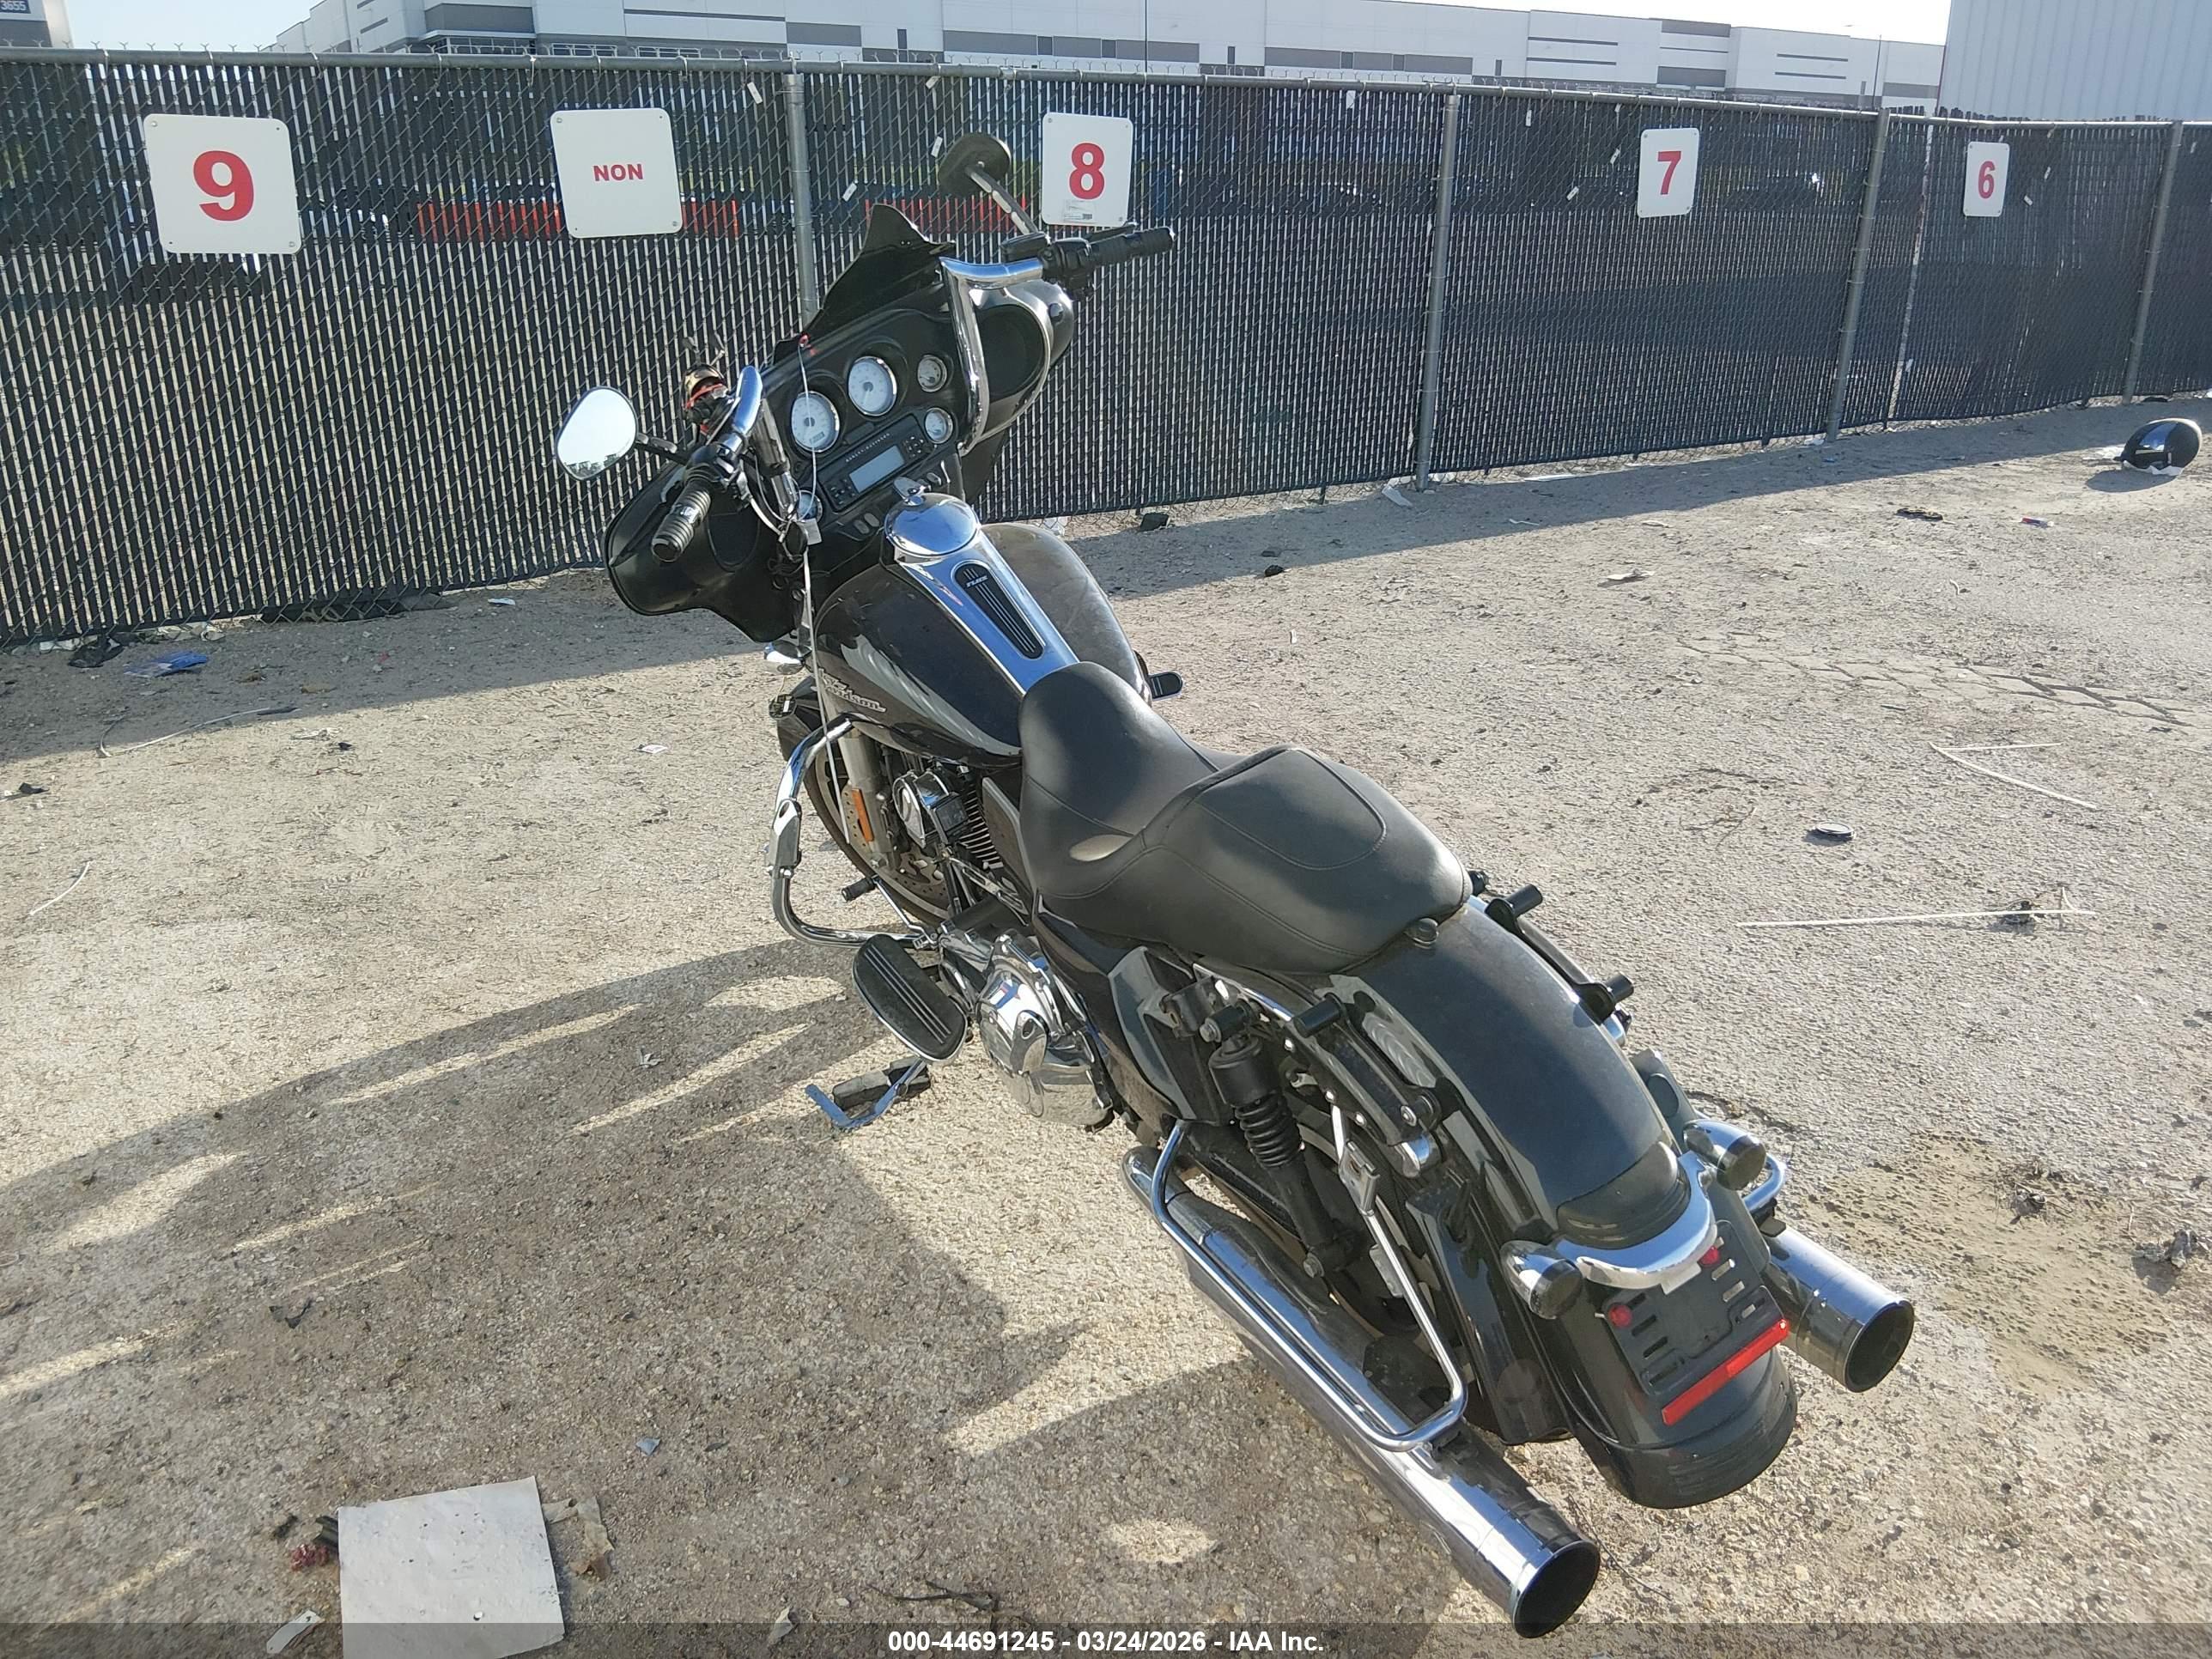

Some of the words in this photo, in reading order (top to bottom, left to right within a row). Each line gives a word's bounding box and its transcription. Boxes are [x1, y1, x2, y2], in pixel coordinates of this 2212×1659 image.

[1, 0, 27, 11] 3655
[193, 151, 255, 221] 9
[593, 163, 643, 181] NON
[1069, 143, 1105, 199] 8
[1657, 150, 1681, 195] 7
[1978, 161, 1995, 198] 6
